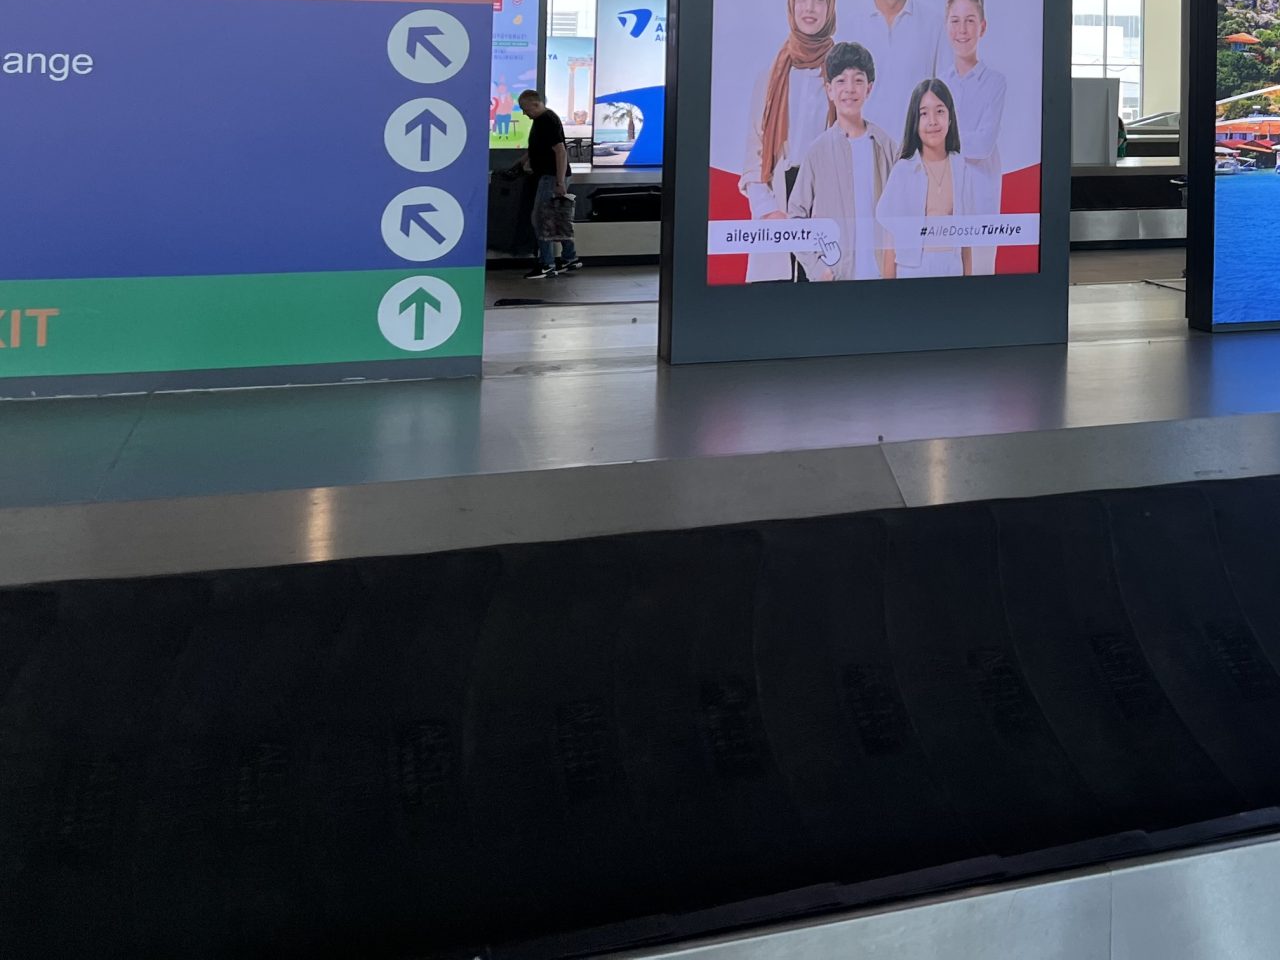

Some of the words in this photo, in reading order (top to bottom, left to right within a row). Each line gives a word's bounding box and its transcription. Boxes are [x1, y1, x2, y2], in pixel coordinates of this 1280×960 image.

[2, 52, 94, 82] ange
[726, 228, 811, 244] aileyili.gov.tr
[920, 224, 1022, 237] #AileDostuTürkiye
[0, 308, 61, 349] IT
